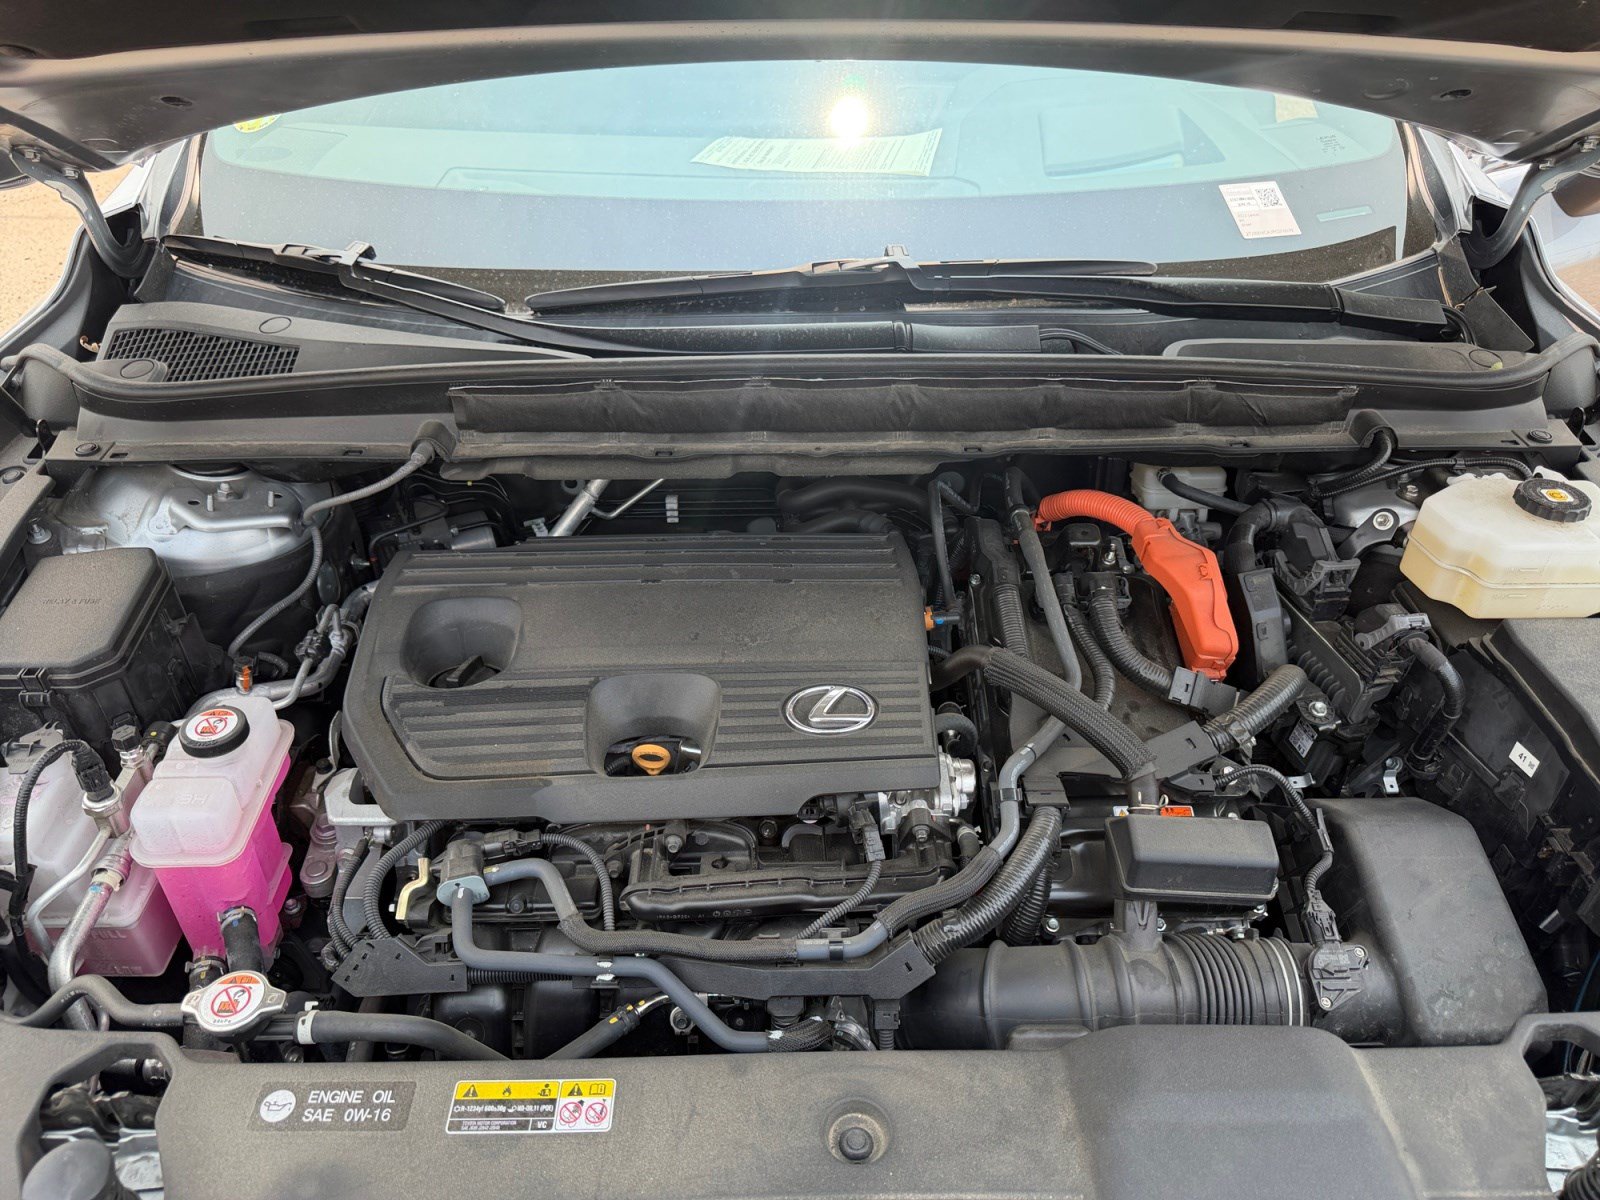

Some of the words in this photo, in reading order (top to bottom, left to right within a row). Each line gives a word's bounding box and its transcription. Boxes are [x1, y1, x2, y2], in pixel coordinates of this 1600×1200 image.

[1518, 752, 1527, 763] 41
[307, 1090, 364, 1104] ENGINE
[372, 1090, 396, 1104] OIL
[302, 1108, 335, 1122] SAE
[343, 1108, 392, 1122] 0W-16
[537, 1121, 547, 1129] VC
